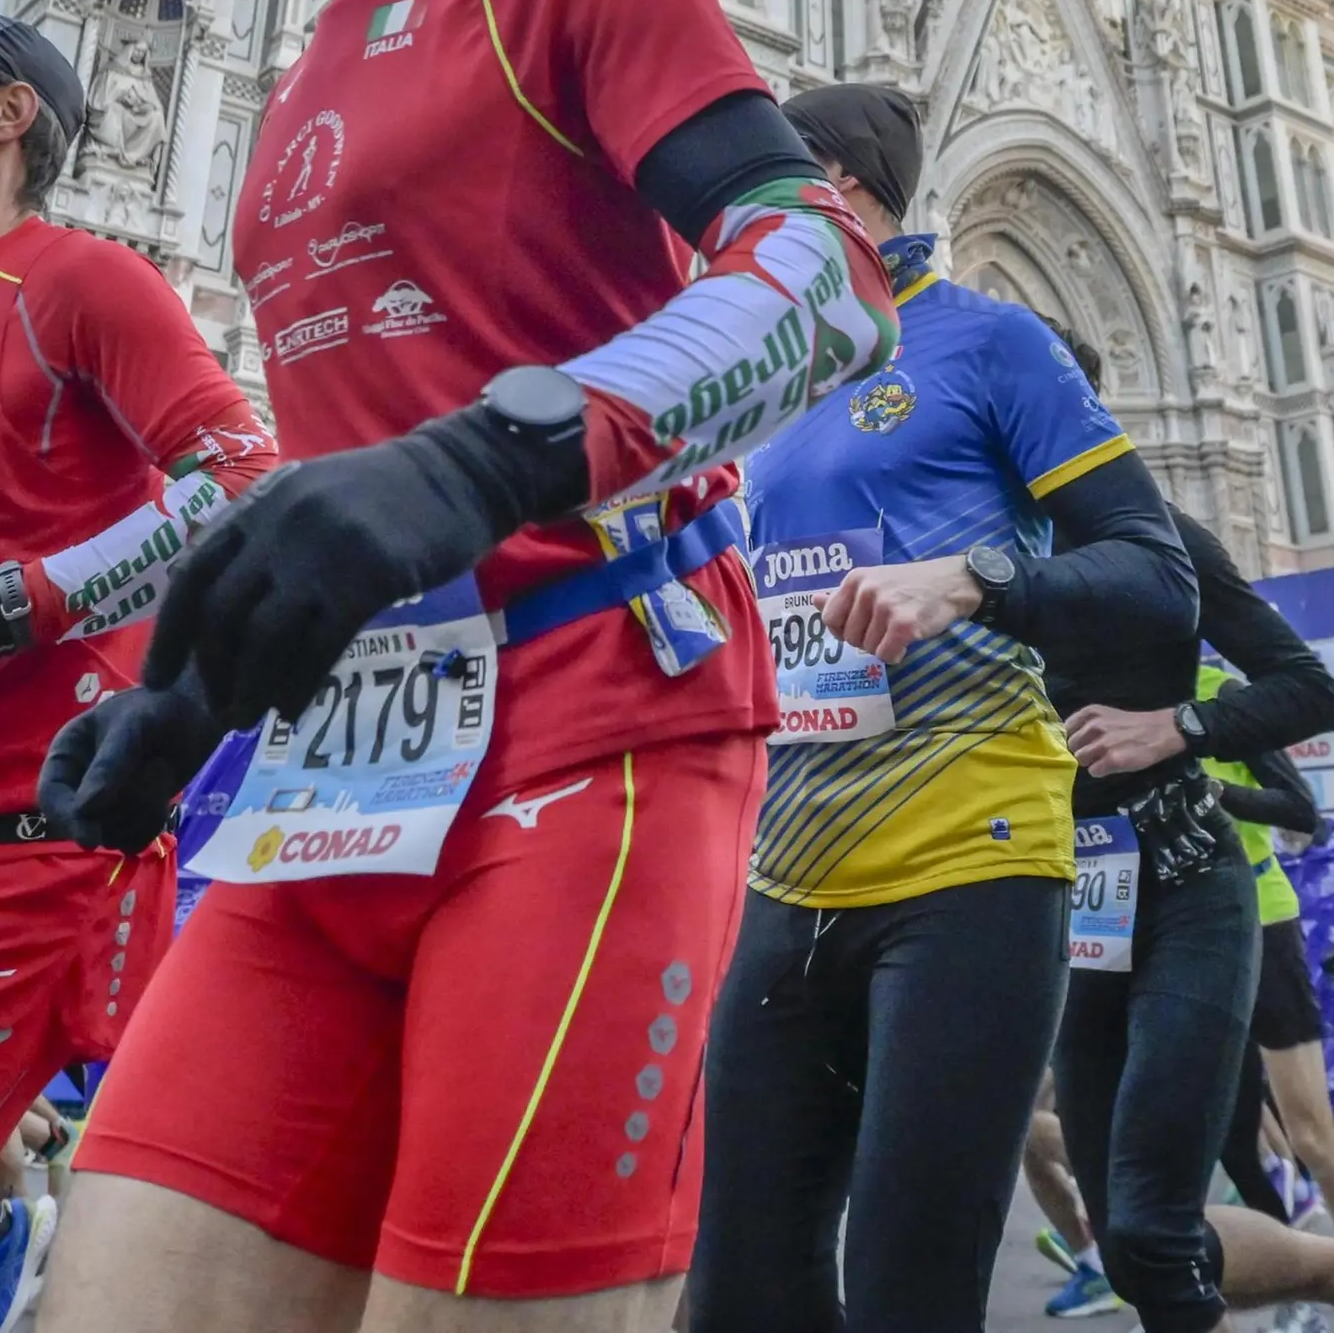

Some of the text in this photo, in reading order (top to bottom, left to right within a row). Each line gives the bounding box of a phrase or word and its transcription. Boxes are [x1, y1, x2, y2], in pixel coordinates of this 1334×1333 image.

[363, 31, 414, 60] ITALIA
[651, 256, 846, 439] del Drago
[68, 480, 217, 611] del Drago
[816, 680, 880, 694] MARATHON
[817, 669, 870, 683] FIRENZE
[302, 663, 439, 770] 2179
[279, 824, 402, 864] CONAD
